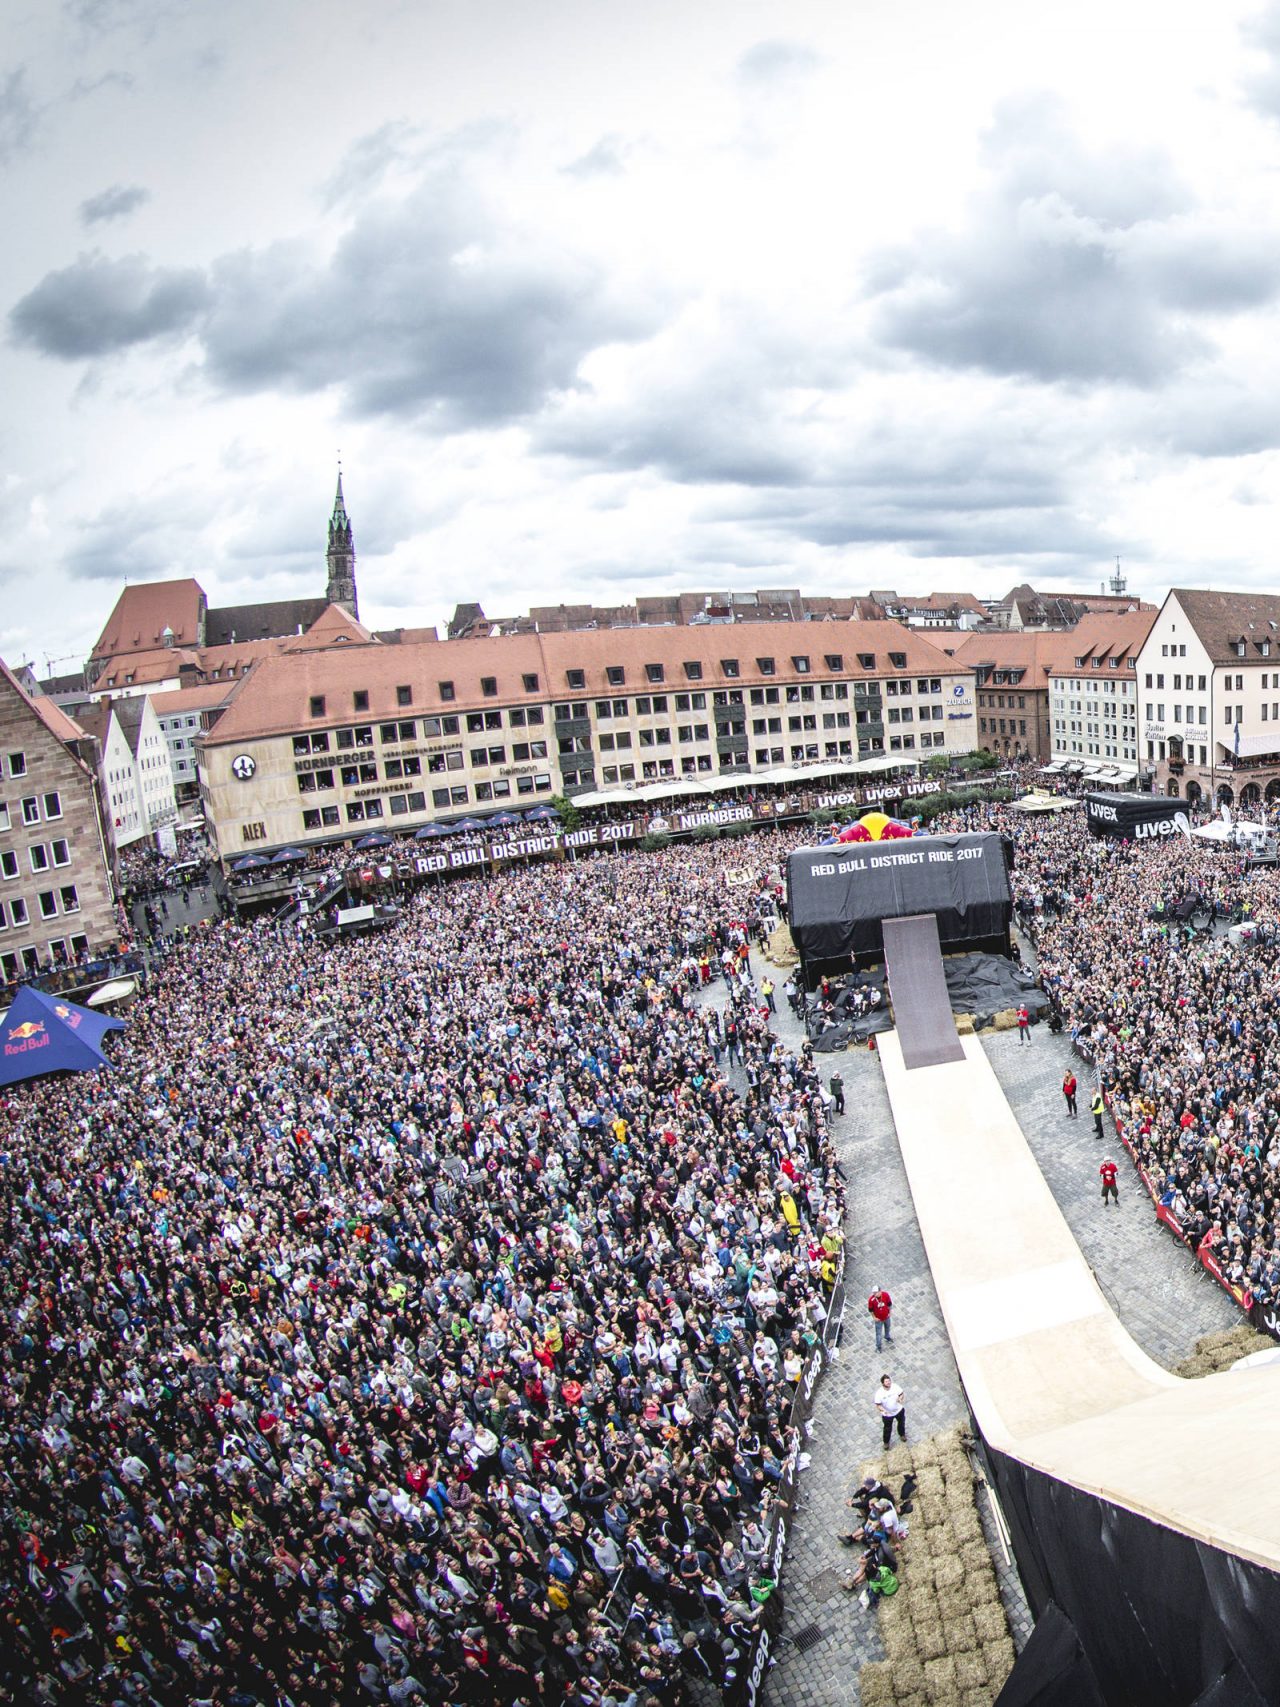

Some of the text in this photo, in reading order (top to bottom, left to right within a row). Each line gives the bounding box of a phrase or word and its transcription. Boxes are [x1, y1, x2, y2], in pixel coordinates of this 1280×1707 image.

[818, 780, 942, 808] uvex uvex uvex
[1089, 802, 1118, 822] uvex
[242, 821, 267, 842] ALEX
[1135, 820, 1181, 839] uvex
[417, 854, 447, 873] RED
[451, 847, 489, 867] BULL
[492, 836, 560, 859] DISTRICT
[565, 828, 598, 847] RIDE
[602, 823, 634, 841] 2017
[811, 847, 983, 877] RED BULL DISTRICT RIDE 2017
[4, 1033, 50, 1056] Red Bull
[804, 1349, 822, 1401] Jeep
[747, 1629, 769, 1707] Jeep
